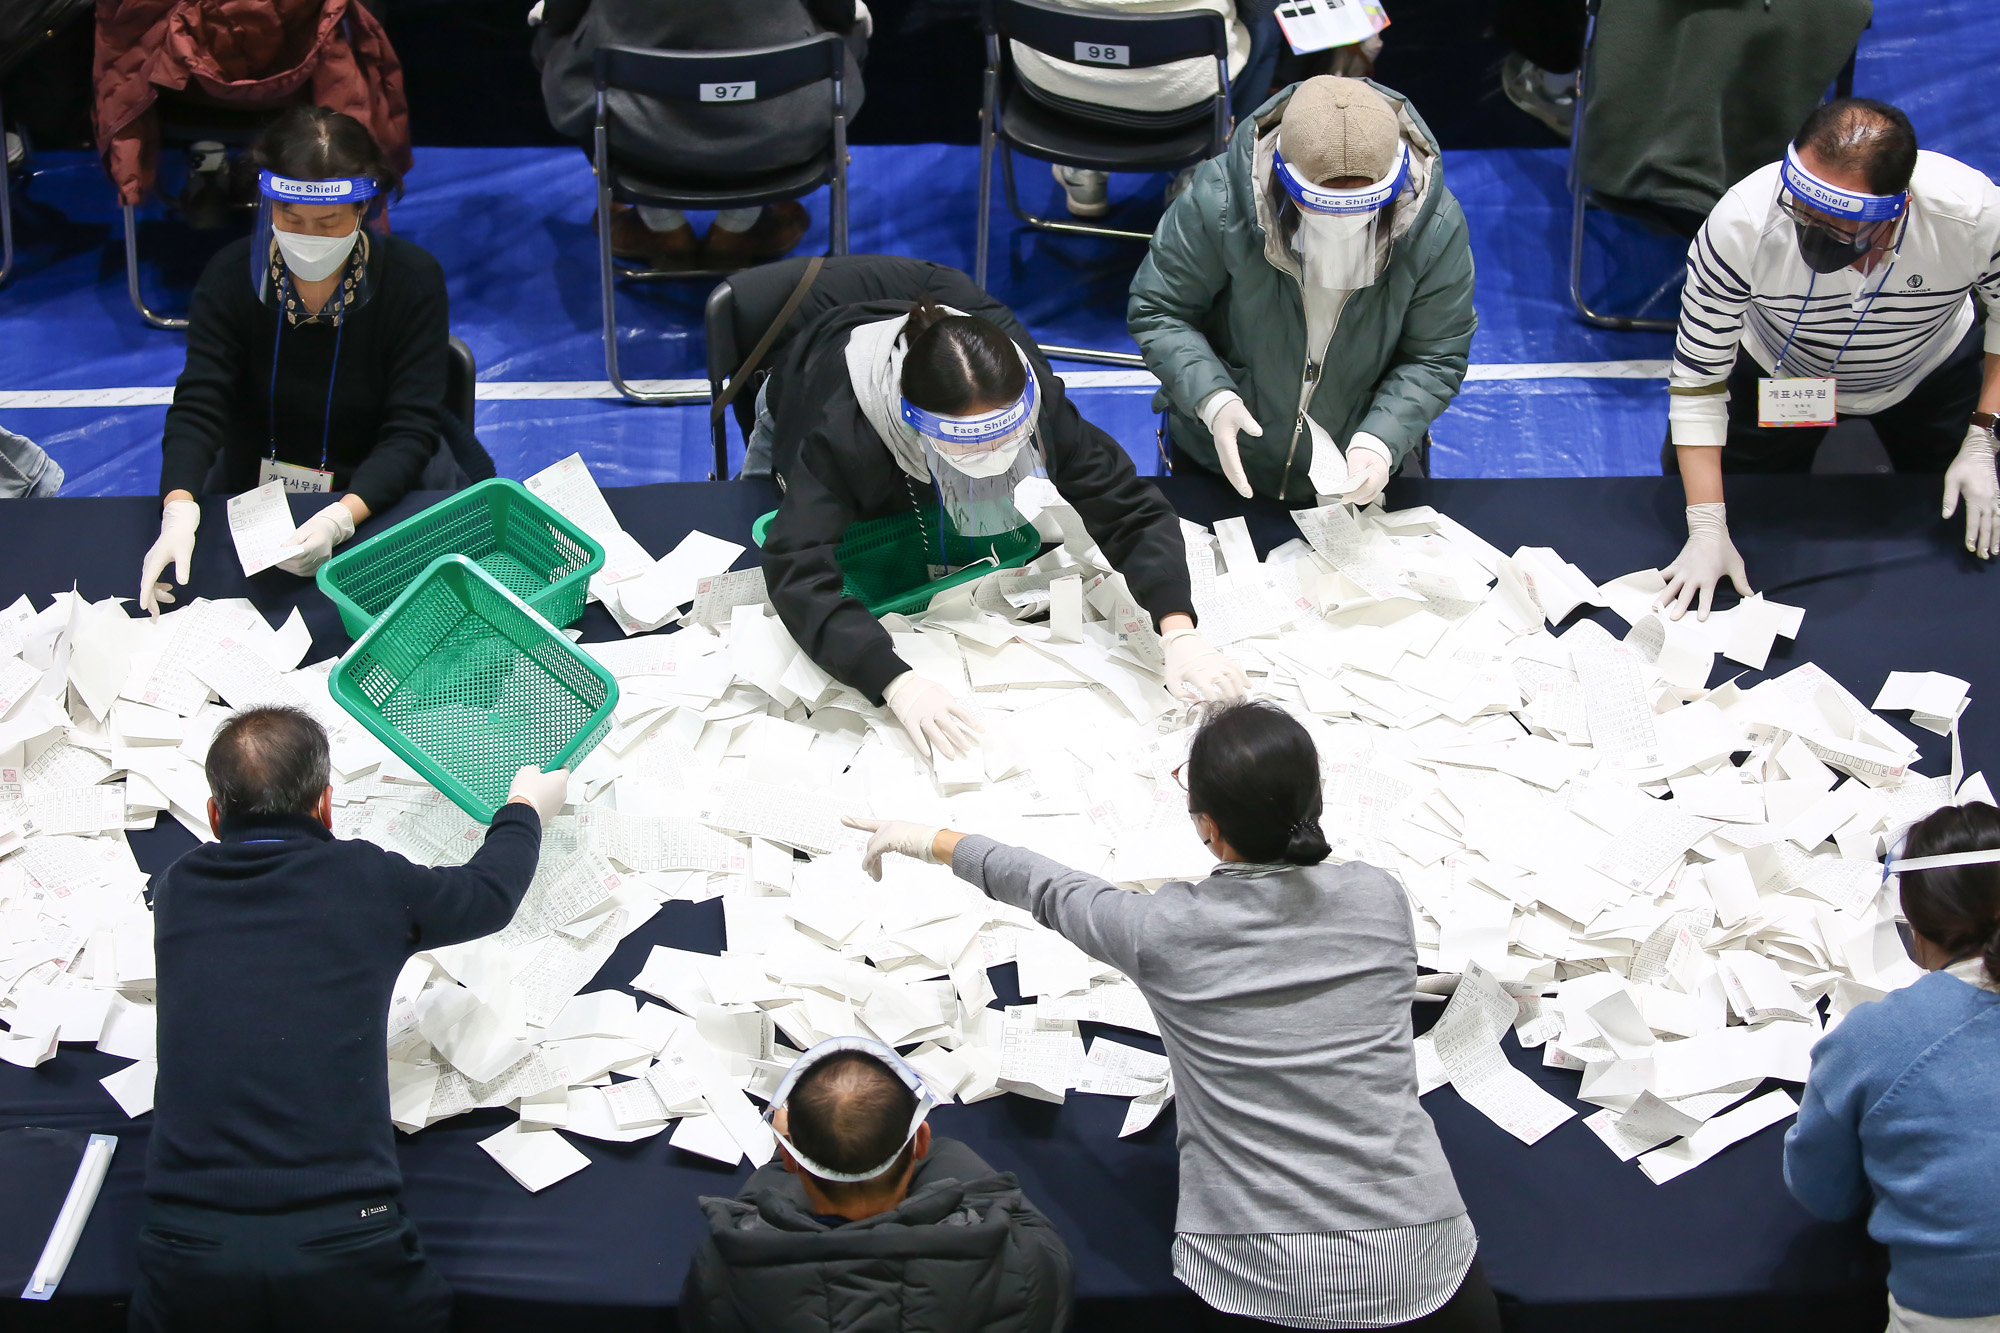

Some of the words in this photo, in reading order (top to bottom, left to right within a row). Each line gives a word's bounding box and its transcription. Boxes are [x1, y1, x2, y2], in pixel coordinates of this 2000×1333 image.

[1088, 45, 1116, 60] 98
[715, 85, 742, 99] 97
[280, 181, 302, 192] Face
[305, 184, 341, 193] Shield
[1792, 174, 1811, 192] Face
[1814, 189, 1850, 208] Shield
[1315, 196, 1341, 206] Face
[1345, 194, 1381, 206] Shield
[1768, 389, 1826, 399] 개표사무원
[953, 426, 980, 434] Face
[984, 411, 1017, 431] Shield
